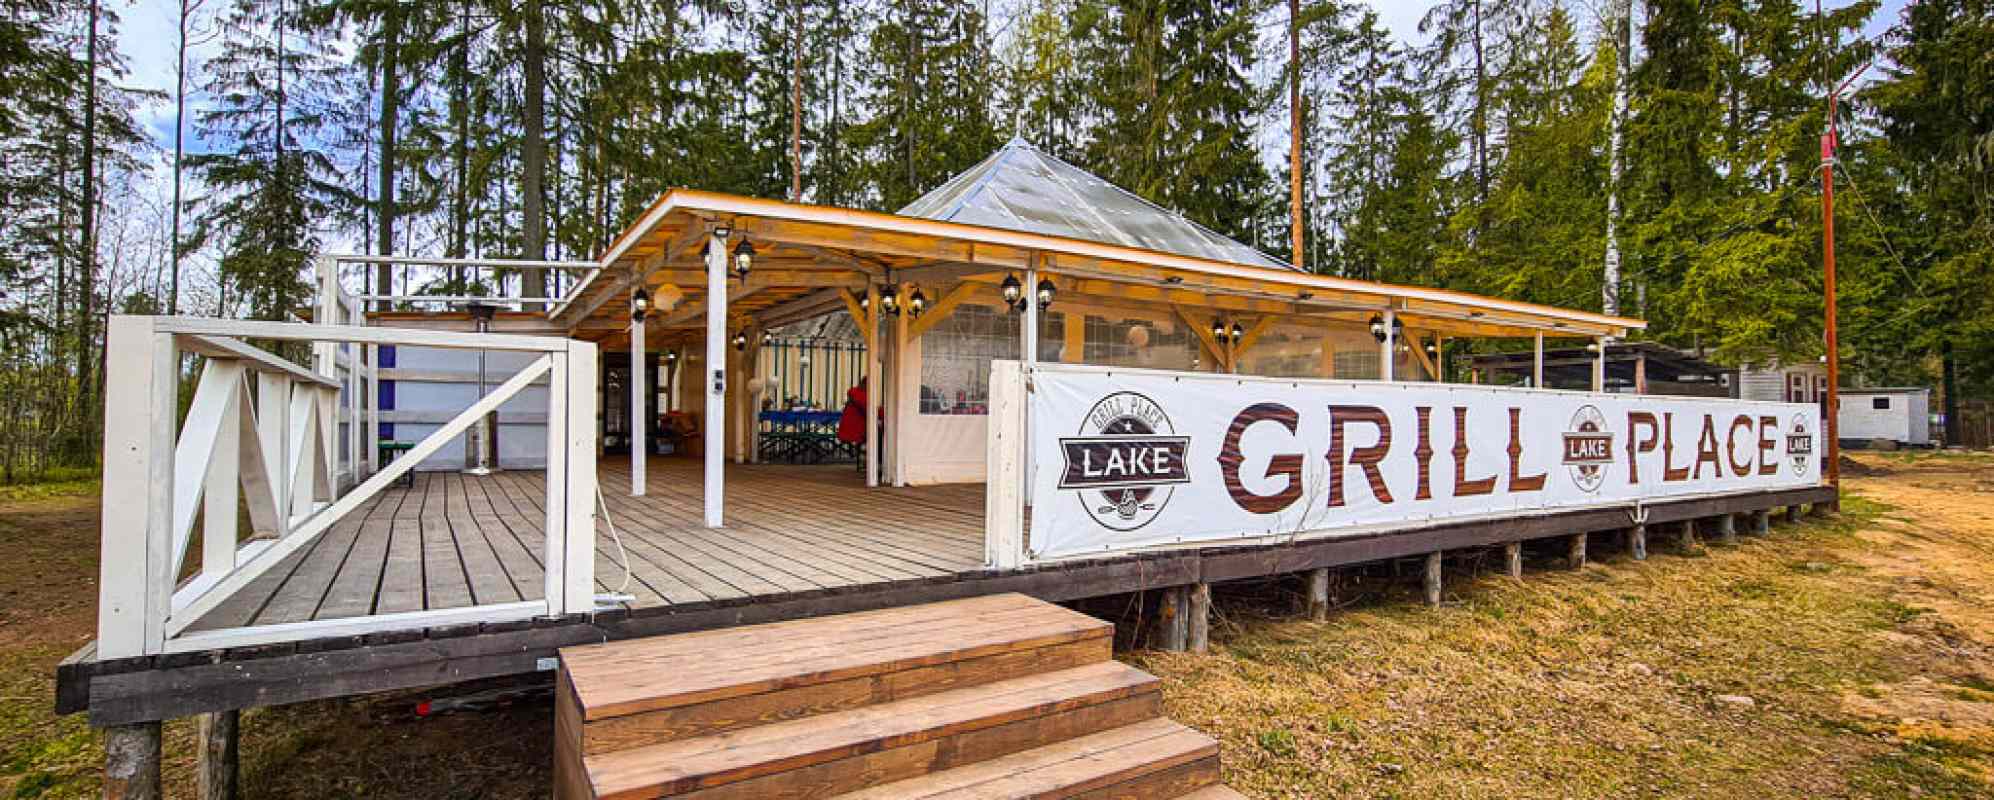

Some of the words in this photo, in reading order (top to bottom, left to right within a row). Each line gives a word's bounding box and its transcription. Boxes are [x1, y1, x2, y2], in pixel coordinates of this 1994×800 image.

[1082, 446, 1172, 477] LAKE
[1217, 402, 1547, 514] GRILL
[1626, 411, 1779, 484] PLACE
[1570, 439, 1607, 458] LAKE
